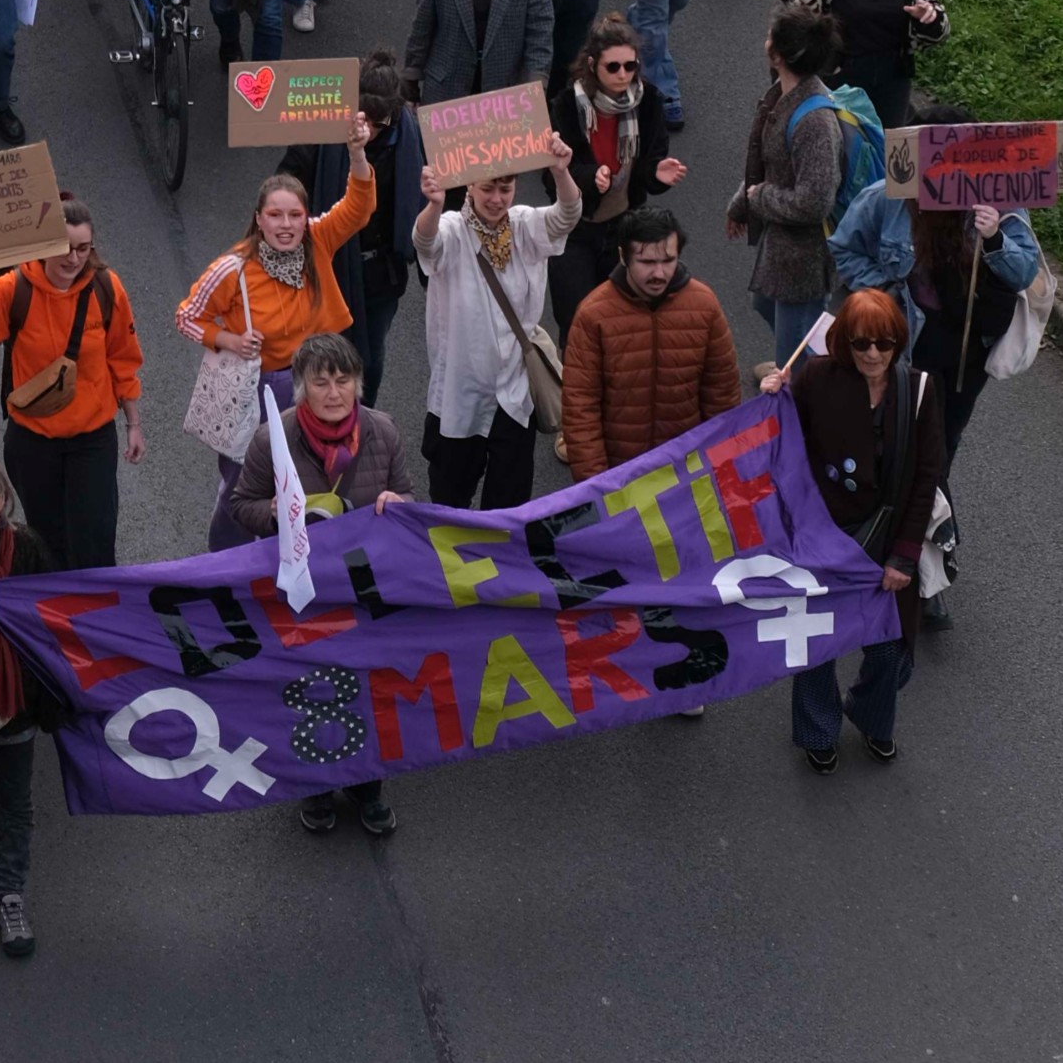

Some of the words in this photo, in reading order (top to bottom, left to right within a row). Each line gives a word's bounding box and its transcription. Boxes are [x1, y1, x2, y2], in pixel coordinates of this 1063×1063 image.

[289, 75, 343, 88] RESPECT
[431, 93, 533, 132] ADELPHES
[929, 127, 959, 145] LA
[953, 149, 1007, 163] L'ODEUR
[1017, 149, 1039, 161] DE
[9, 169, 28, 181] DES
[5, 199, 32, 213] DES
[282, 666, 367, 764] 8
[368, 606, 729, 761] MARS
